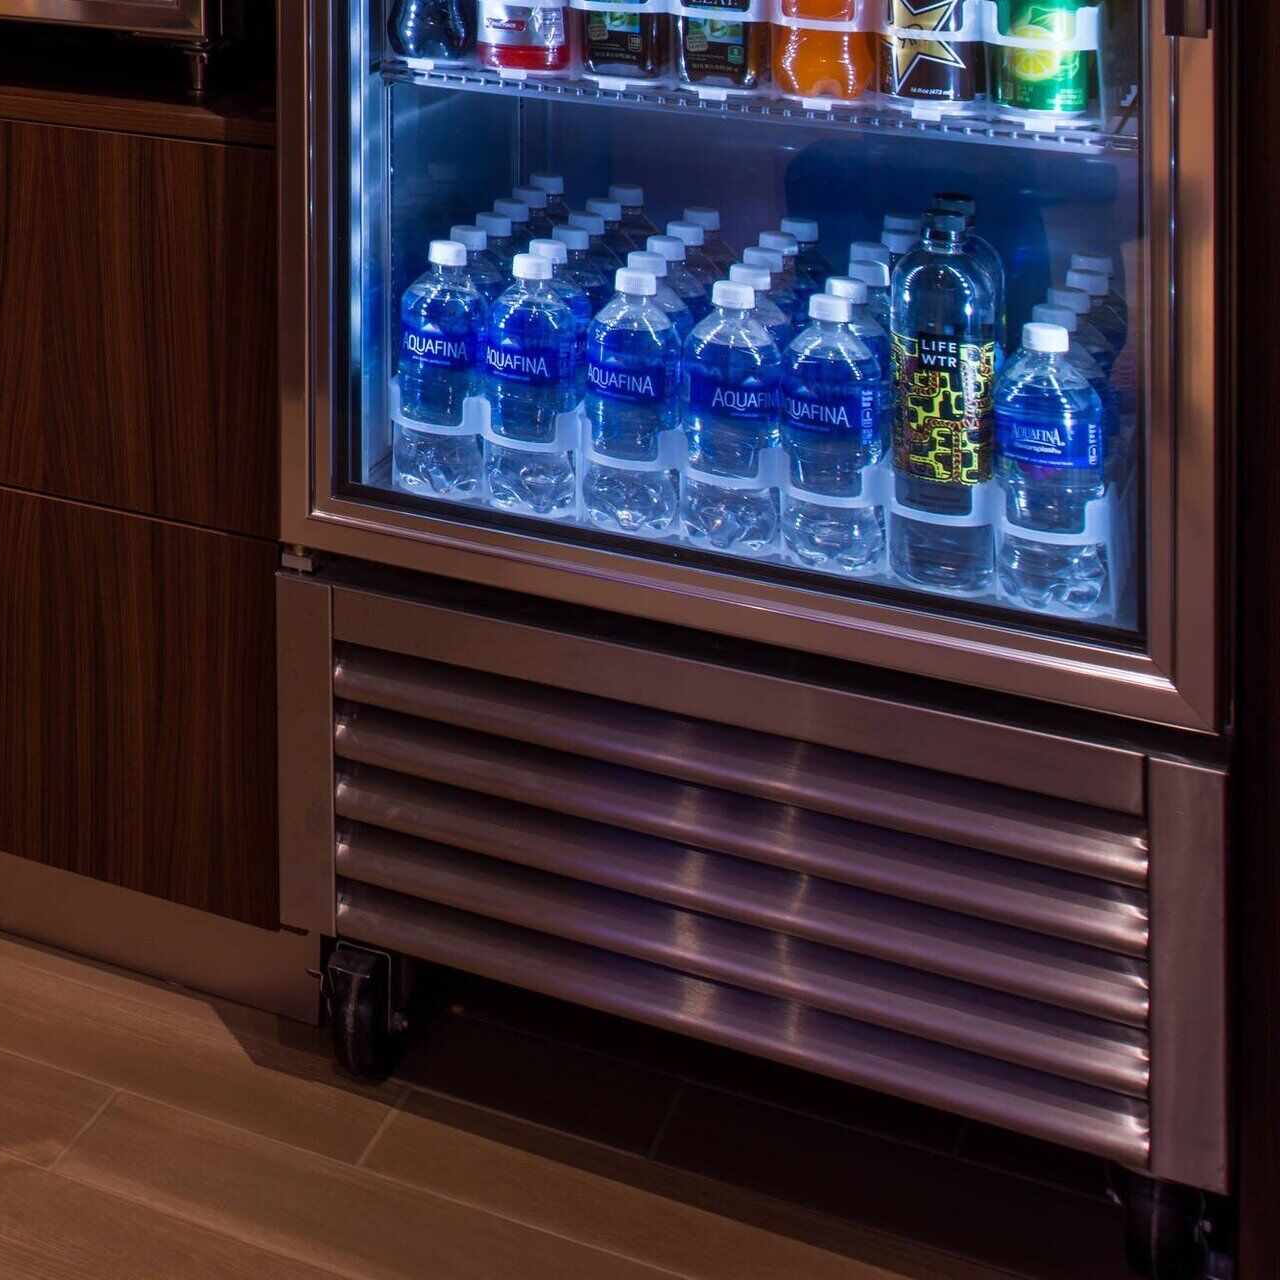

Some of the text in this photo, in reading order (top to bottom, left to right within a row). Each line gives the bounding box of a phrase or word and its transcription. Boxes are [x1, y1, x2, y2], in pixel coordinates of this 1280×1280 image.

[402, 332, 469, 360] AQUAFINA
[921, 339, 958, 355] LIFE
[485, 346, 550, 378] AQUAFINA
[920, 354, 958, 369] WTR
[588, 363, 655, 396] AQUAFINA
[1011, 423, 1062, 447] AQUAFINA
